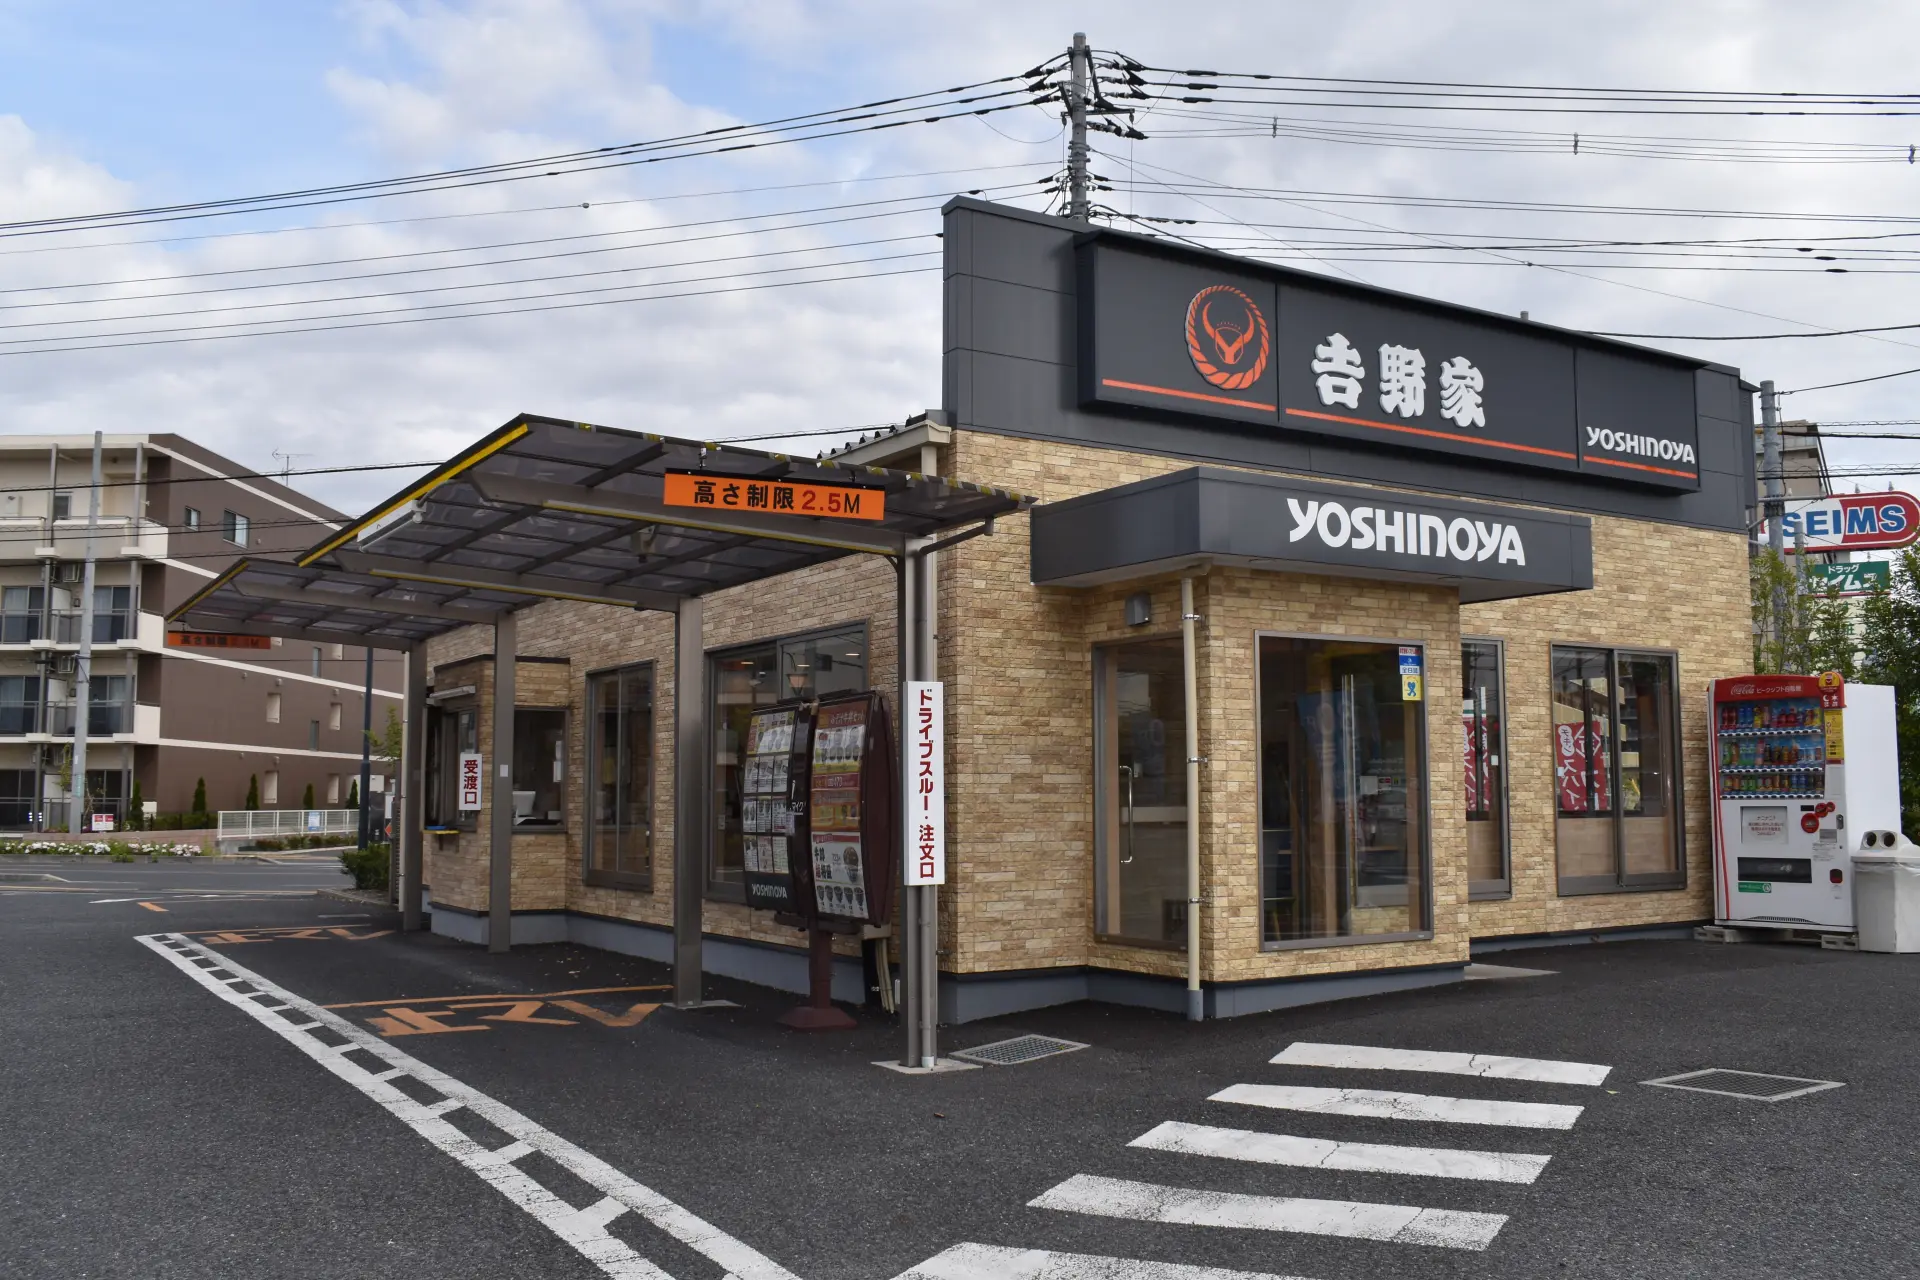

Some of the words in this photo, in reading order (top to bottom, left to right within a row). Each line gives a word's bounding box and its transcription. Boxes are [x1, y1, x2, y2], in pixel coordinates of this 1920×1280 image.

[1586, 426, 1695, 464] YOSHINOYA
[694, 480, 794, 510] 高さ制限
[801, 490, 860, 514] 2.5M
[1287, 498, 1525, 565] YOSHINOYA
[1782, 504, 1906, 537] SEIMS
[1828, 564, 1859, 574] ドラッグ
[464, 760, 478, 804] 受渡口
